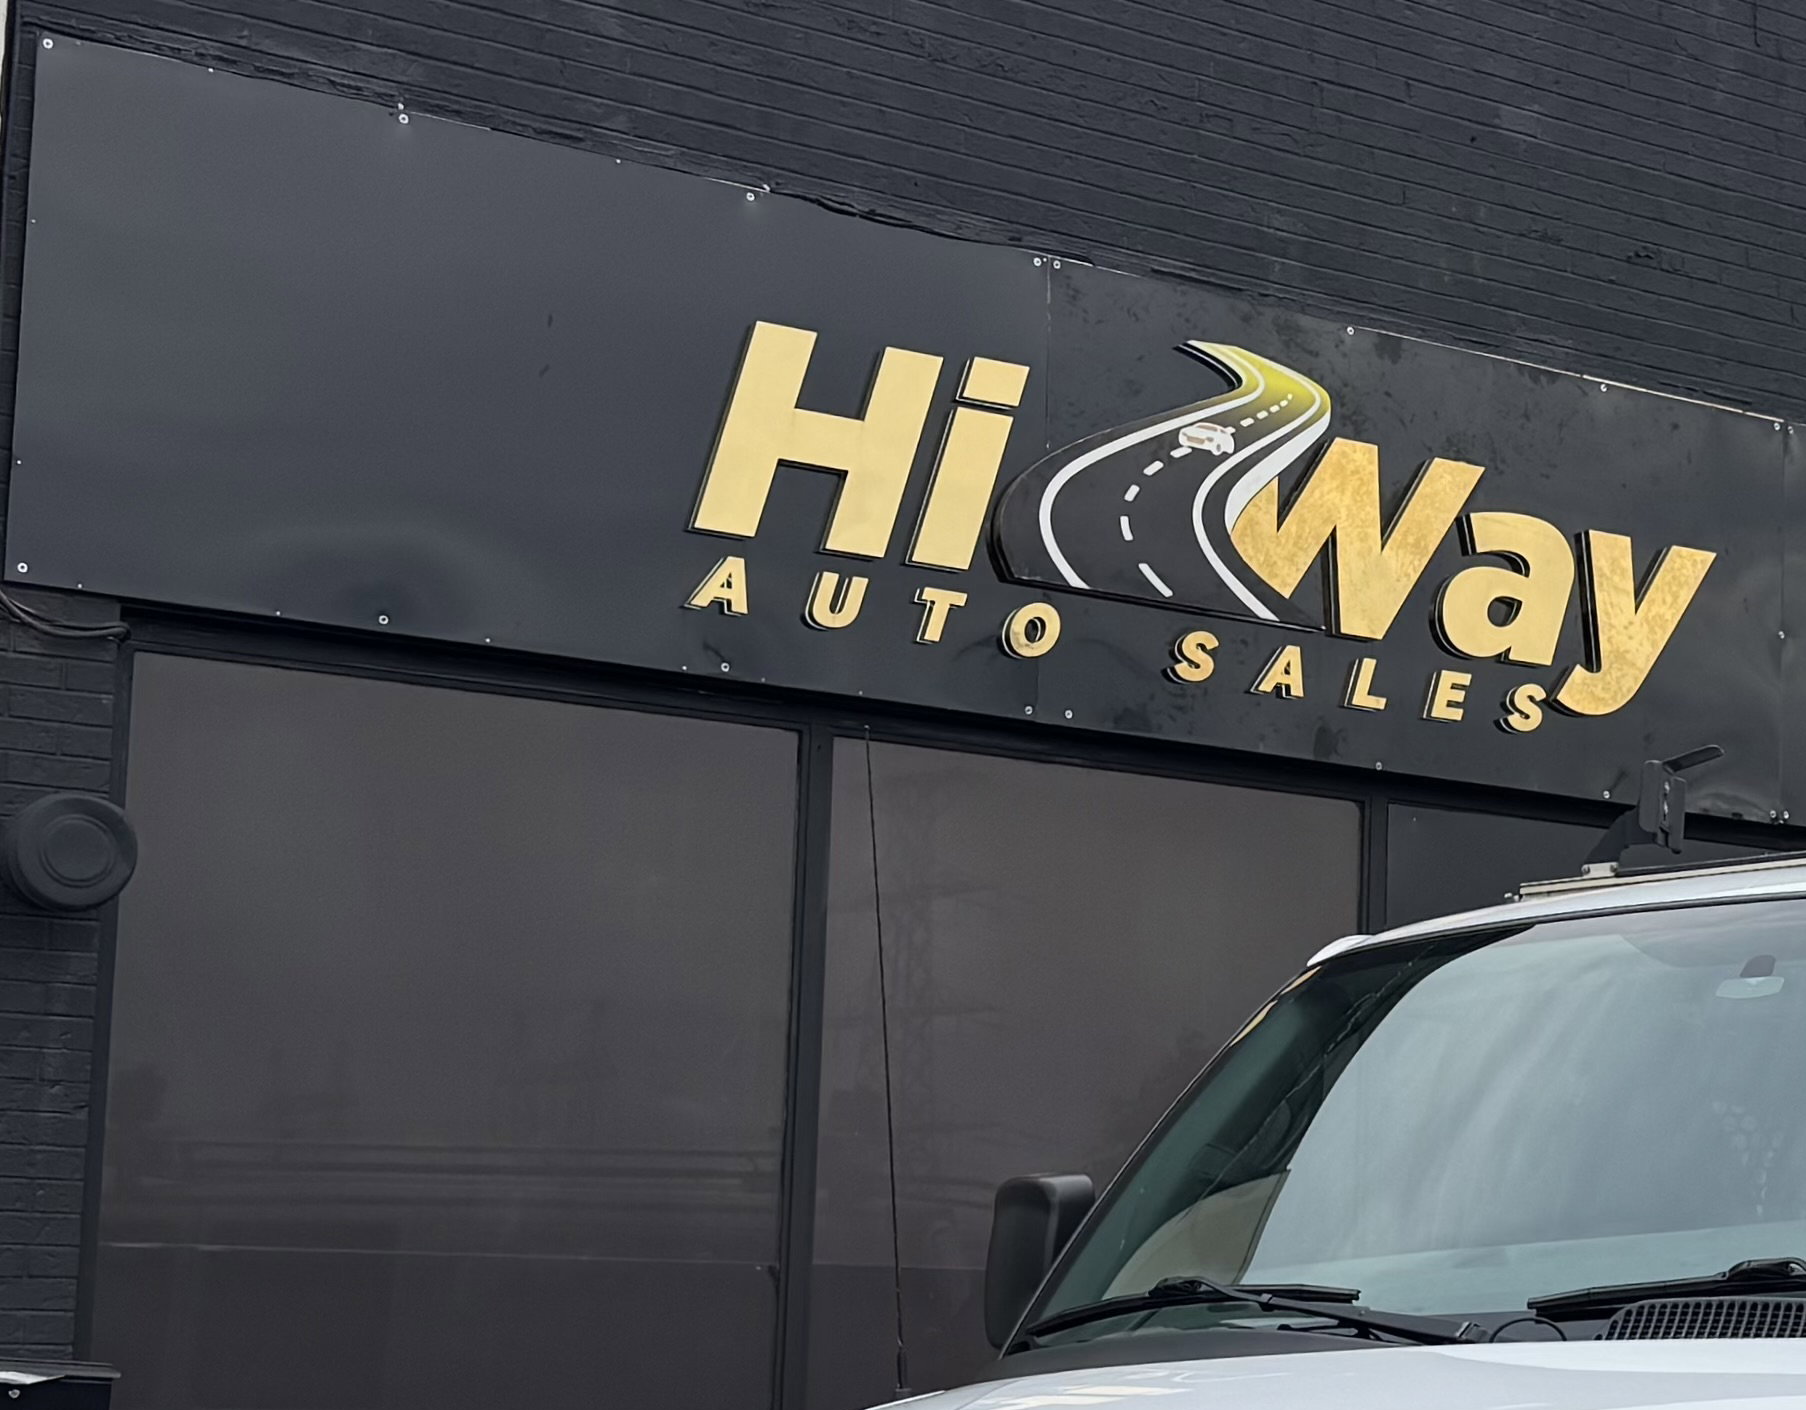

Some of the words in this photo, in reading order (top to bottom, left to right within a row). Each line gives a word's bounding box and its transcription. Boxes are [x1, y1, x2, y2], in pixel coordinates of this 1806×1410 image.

[684, 555, 1061, 659] AUTO
[1169, 630, 1548, 734] SALES
[687, 320, 1030, 571] Hi
[1226, 437, 1717, 717] Way
